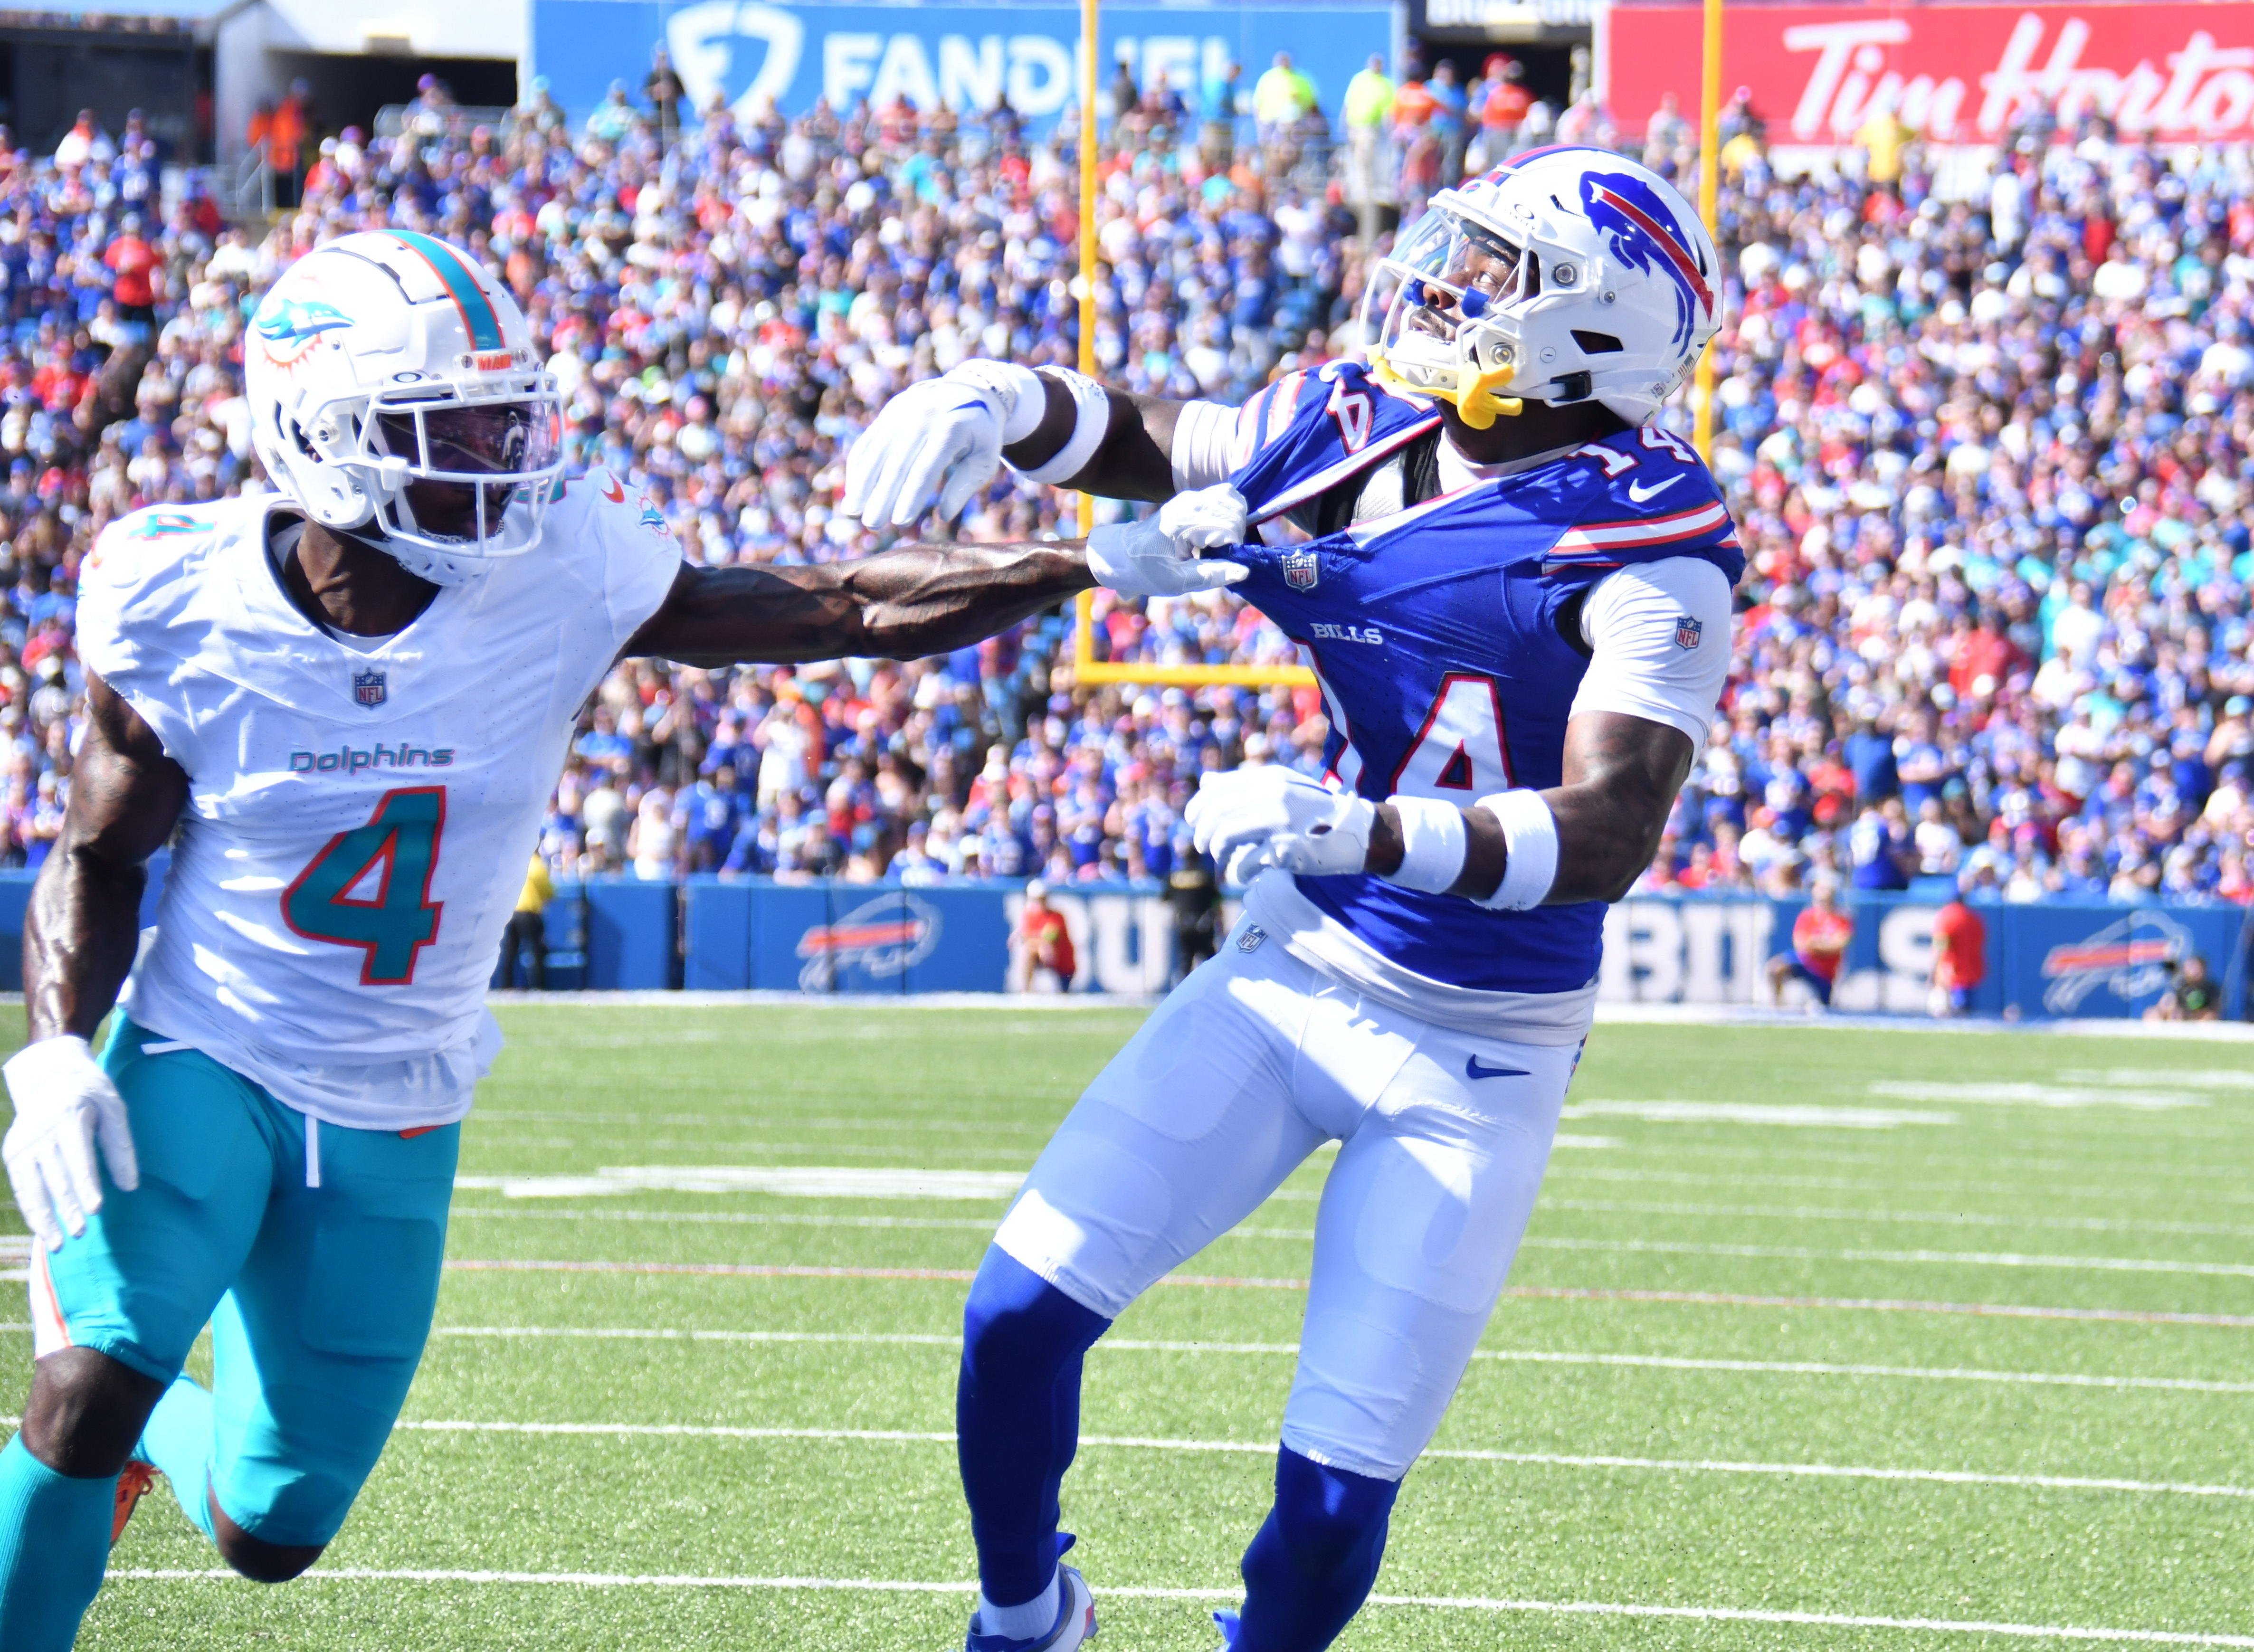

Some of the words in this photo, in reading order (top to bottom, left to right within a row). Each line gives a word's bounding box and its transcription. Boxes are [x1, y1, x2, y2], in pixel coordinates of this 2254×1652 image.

[1782, 18, 1967, 142] Tim
[1564, 427, 1697, 480] 14
[1289, 569, 1312, 585] NFL
[1310, 623, 1383, 646] BILLS
[1677, 628, 1697, 647] NFL
[357, 685, 384, 703] NFL
[287, 743, 455, 775] Dolphins
[279, 785, 447, 986] 4
